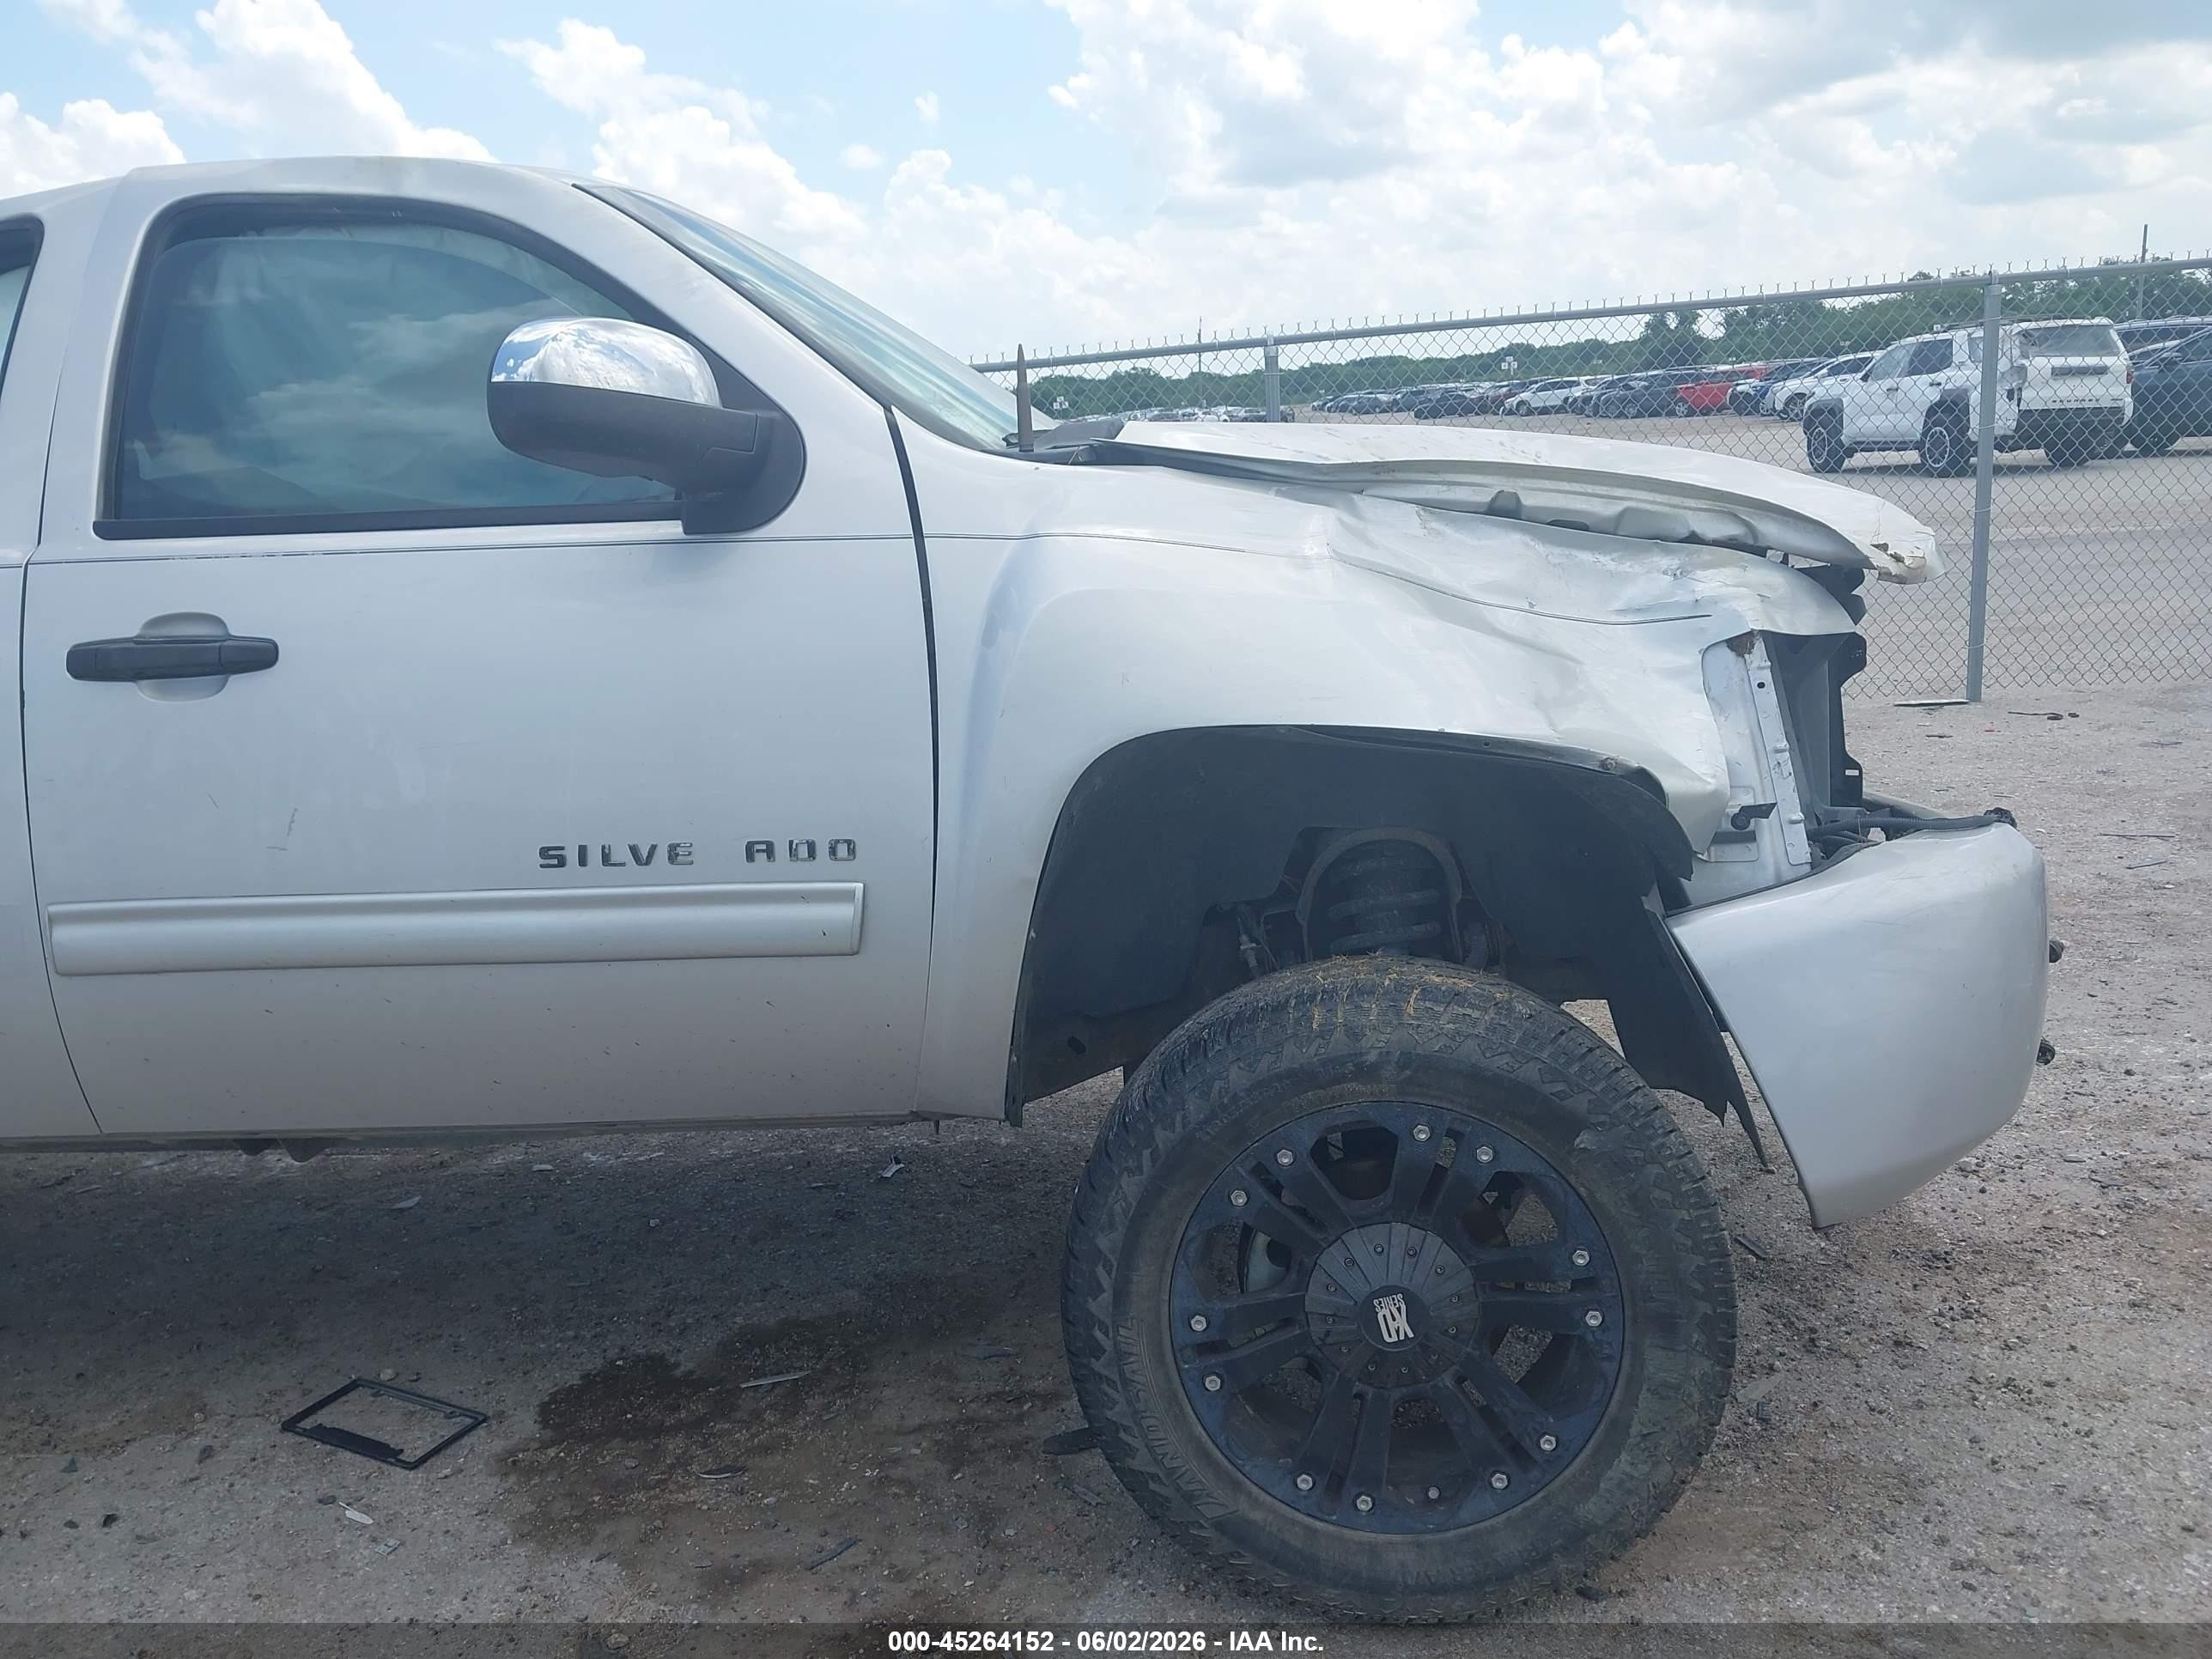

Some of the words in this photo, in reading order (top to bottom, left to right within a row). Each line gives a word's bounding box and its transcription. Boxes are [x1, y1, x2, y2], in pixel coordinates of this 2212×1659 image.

[538, 842, 694, 868] SILVE
[744, 838, 857, 863] ADO
[1373, 1293, 1406, 1313] SERIES
